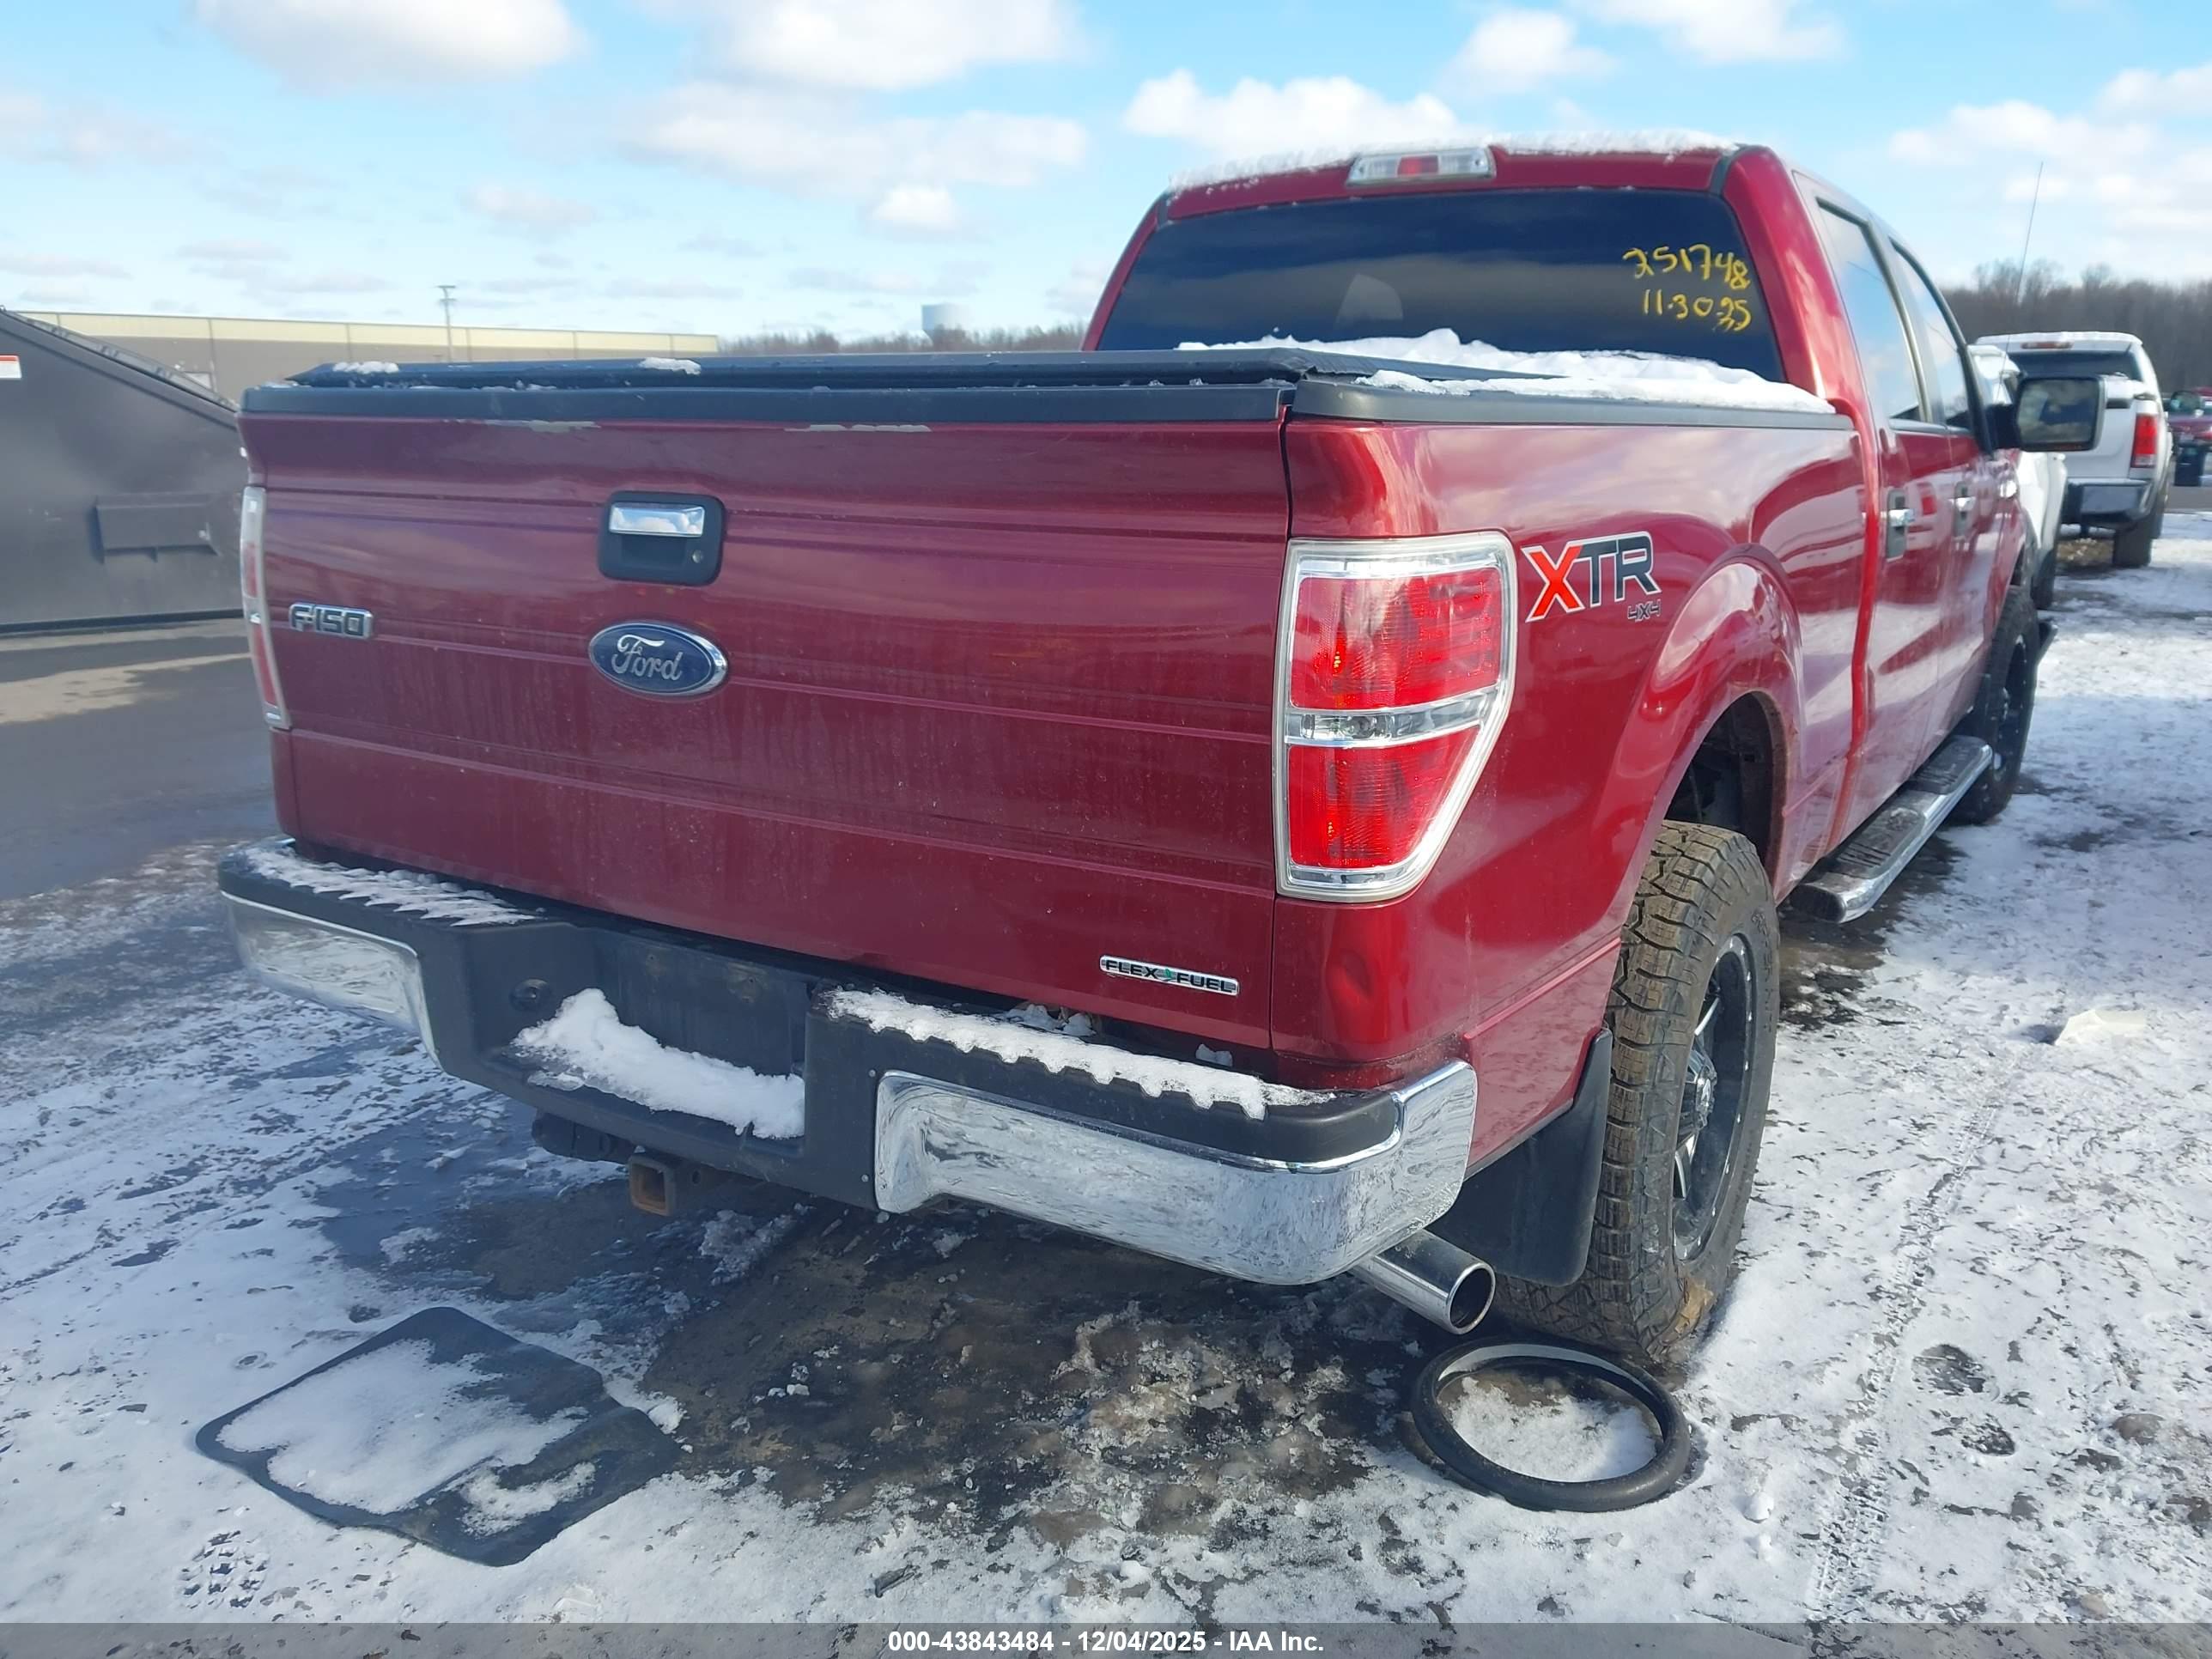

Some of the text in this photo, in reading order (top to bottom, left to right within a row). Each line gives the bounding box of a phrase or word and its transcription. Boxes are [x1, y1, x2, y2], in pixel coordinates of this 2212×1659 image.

[1622, 243, 1751, 289] 251748
[1521, 531, 1662, 623] XTR
[611, 634, 684, 682] Ford
[1105, 959, 1234, 993] FLEX FUEL
